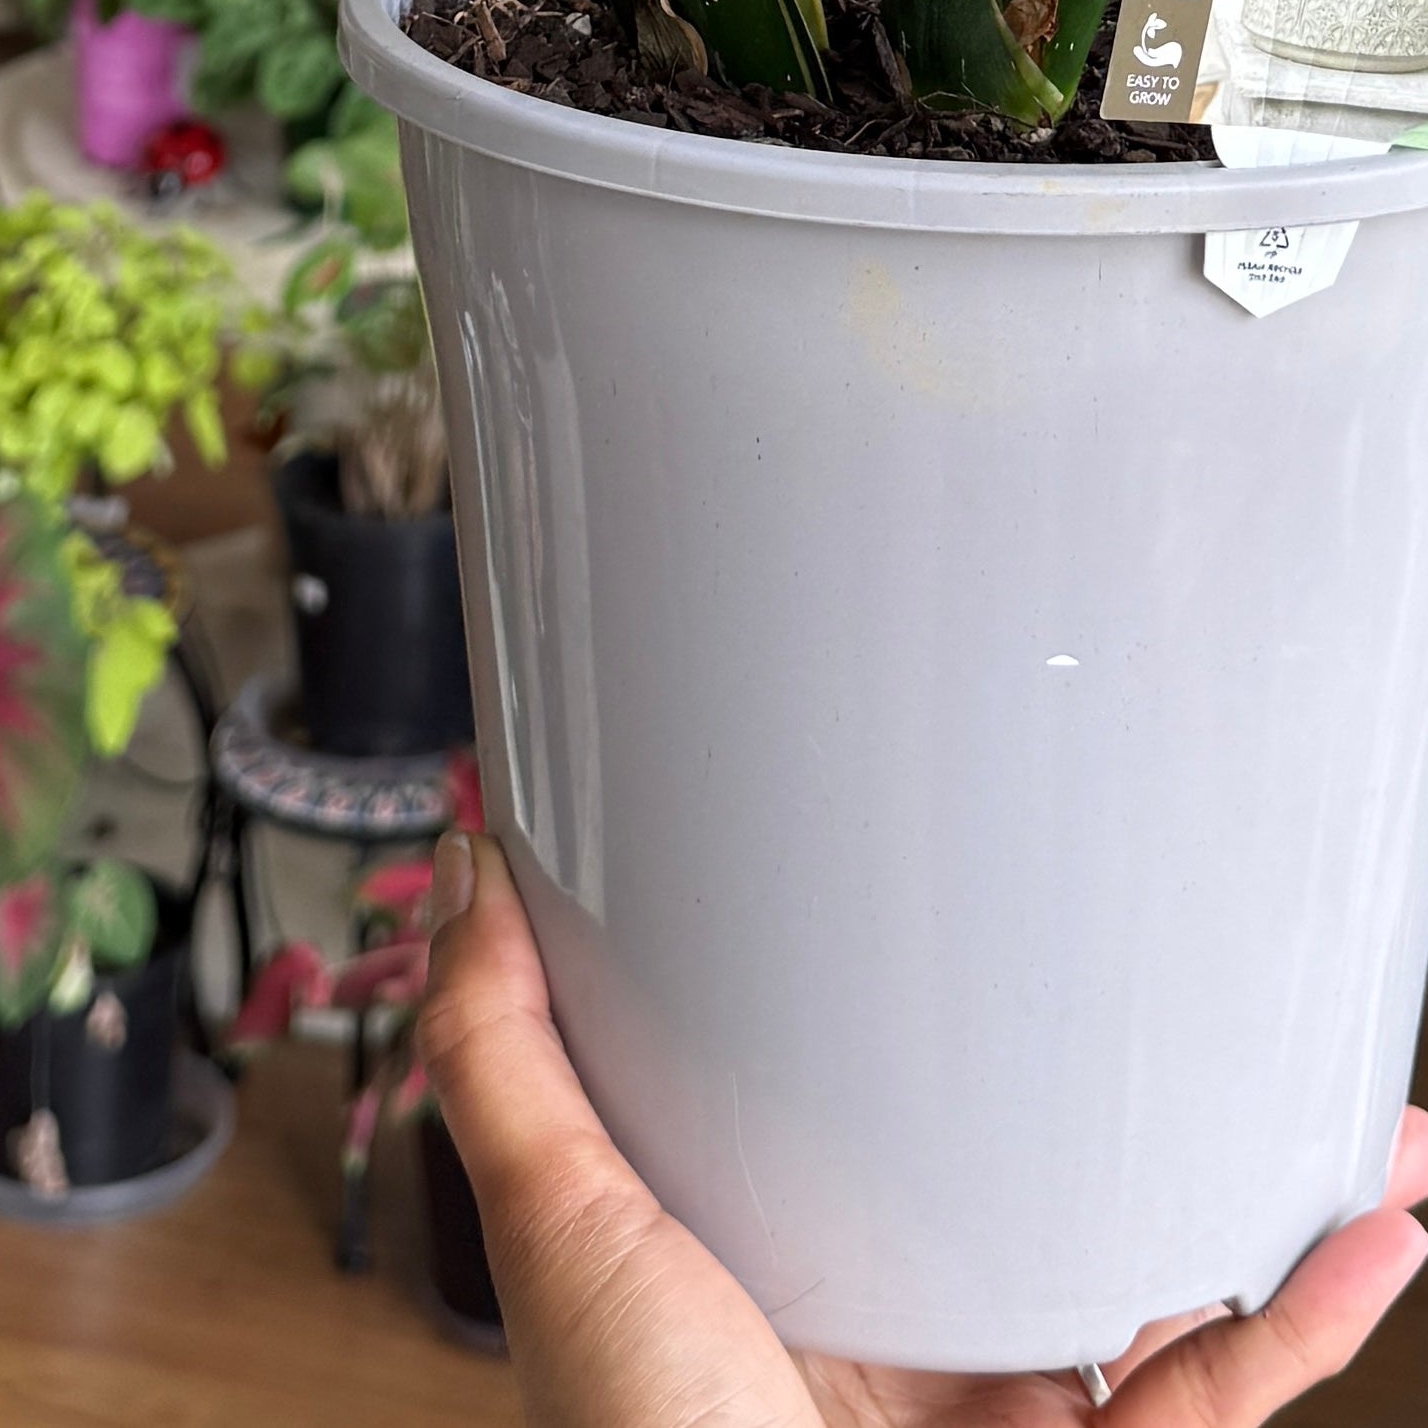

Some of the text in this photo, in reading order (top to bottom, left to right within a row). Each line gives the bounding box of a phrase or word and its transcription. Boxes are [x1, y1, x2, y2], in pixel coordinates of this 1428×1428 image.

[1126, 73, 1180, 91] EASY TO
[1129, 90, 1172, 106] GROW
